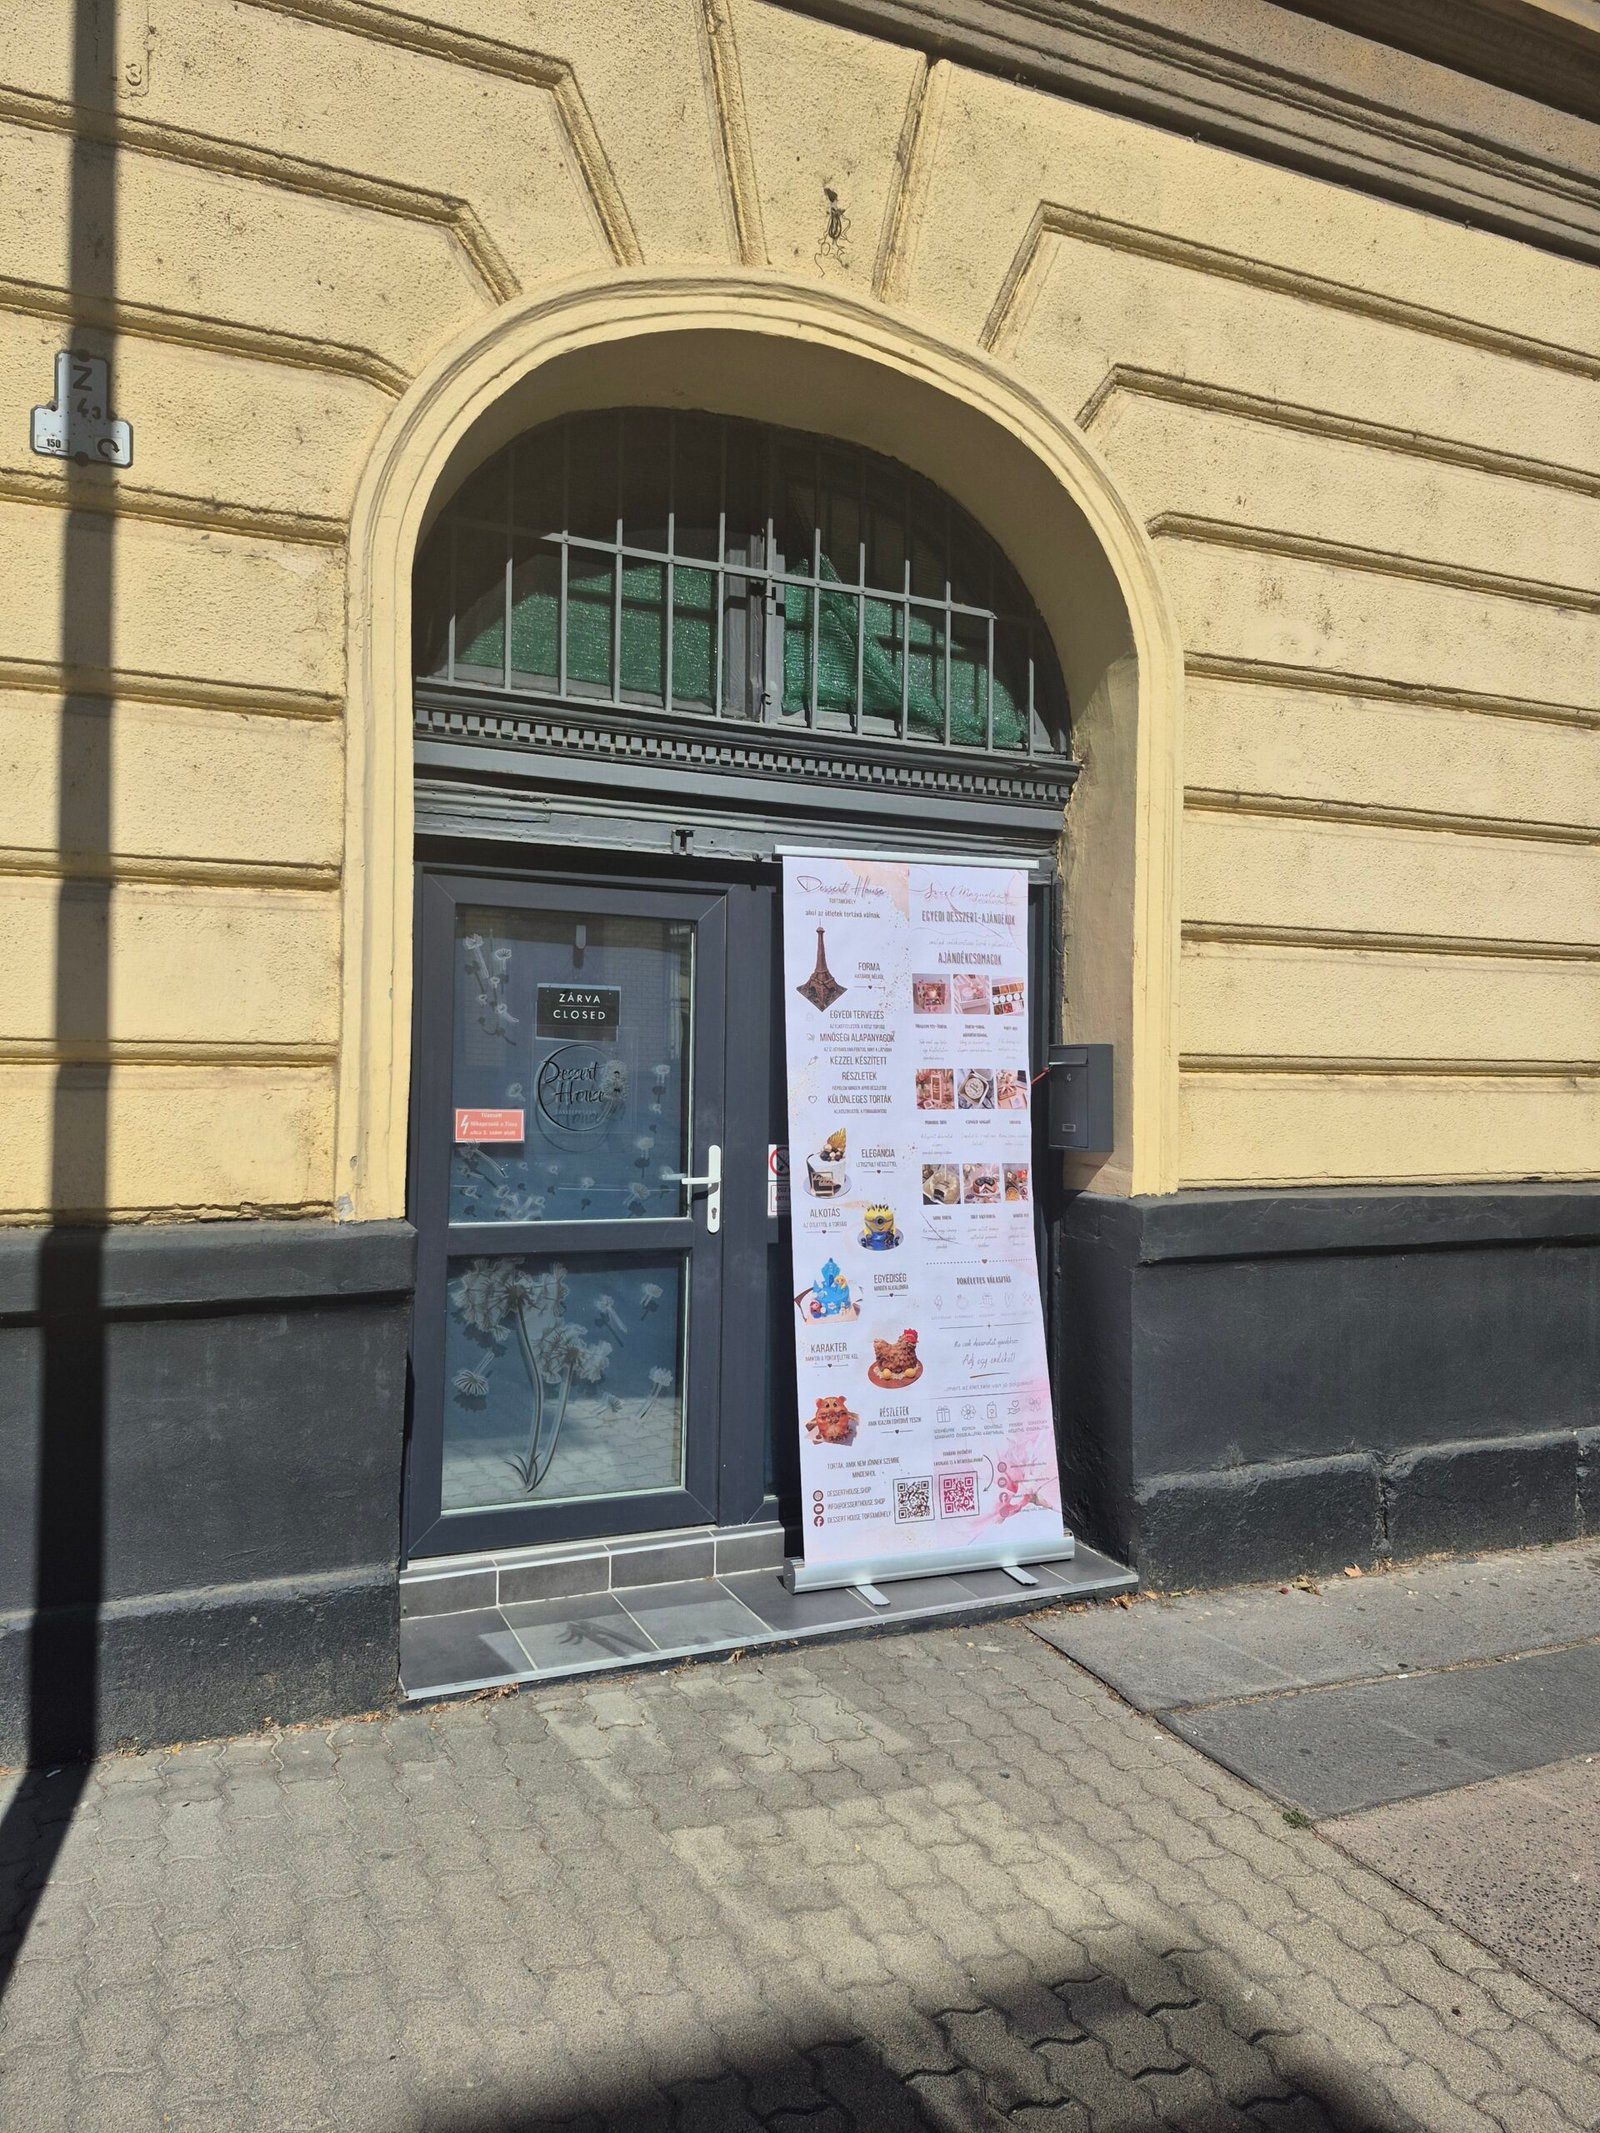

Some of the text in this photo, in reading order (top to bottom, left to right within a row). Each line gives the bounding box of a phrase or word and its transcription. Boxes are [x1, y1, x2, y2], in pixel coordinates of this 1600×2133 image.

[46, 438, 61, 448] 150
[796, 875, 886, 898] Dessert House
[922, 910, 945, 922] EGYEDI
[938, 949, 1002, 966] AJÁNDÉKCSOMAGOK
[858, 961, 881, 971] FORMA
[559, 992, 601, 1003] ZÁRVA
[553, 1009, 606, 1020] CLOSED
[830, 1009, 885, 1020] EGYEDI TERVEZÉS
[819, 1031, 895, 1043] MINŐSÉGI ALAPANYAGOK
[830, 1055, 887, 1065] KÉZZEL KÉSZÍTETT
[542, 1060, 604, 1084] Dessert
[841, 1071, 878, 1081] RÉSZLETEK
[555, 1080, 606, 1105] House
[827, 1093, 893, 1104] KÜLÖNLEGES TORTÁK
[861, 1149, 896, 1158] ELEGANCIA
[810, 1207, 841, 1218] ALKOTÁS
[873, 1272, 907, 1284] EGYEDISÉG
[956, 1275, 986, 1286] TÖKÉLETES
[810, 1342, 848, 1353] KARAKTER
[879, 1406, 910, 1417] RÉSZLETEK
[827, 1515, 846, 1524] DESSERT
[846, 1513, 861, 1521] HOUSE
